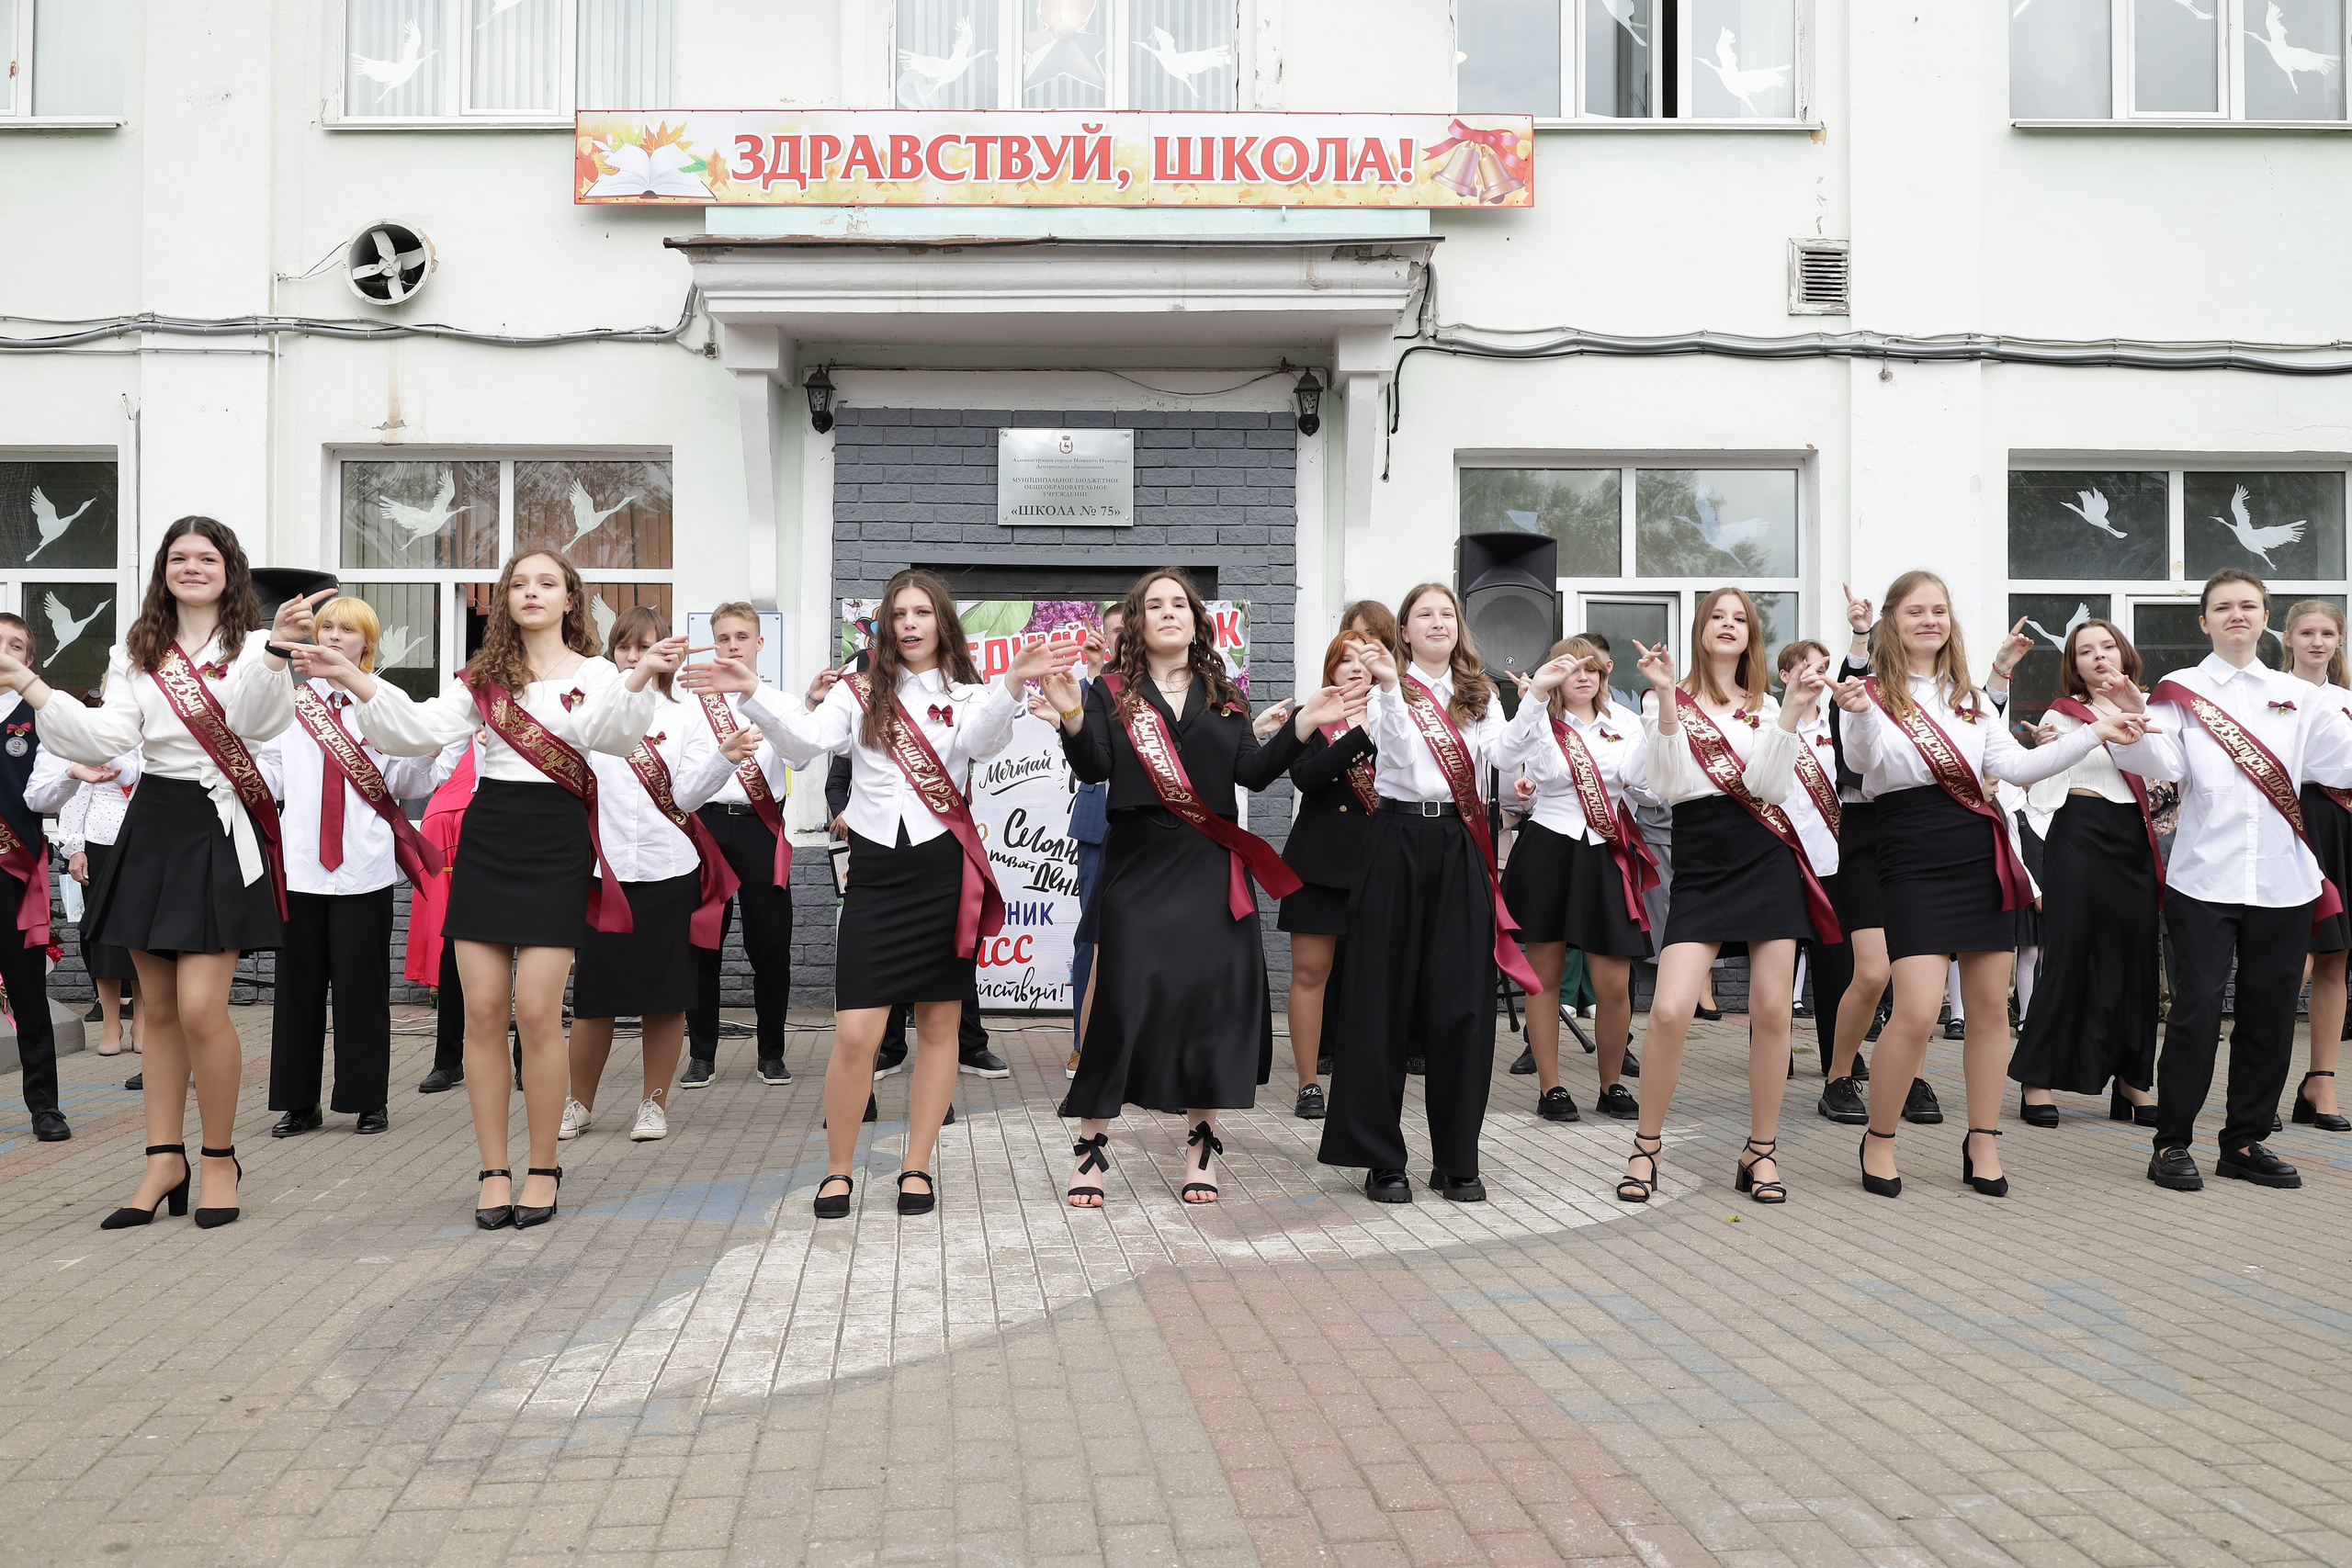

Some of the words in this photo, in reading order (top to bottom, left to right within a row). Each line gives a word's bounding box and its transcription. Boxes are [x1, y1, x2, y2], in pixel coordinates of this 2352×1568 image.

[733, 123, 1128, 189] ЗДРАВСТВУЙ,
[1154, 136, 1416, 183] ШКОЛА!
[1011, 505, 1076, 516] «ШКОЛА
[1080, 505, 1097, 516] №
[1100, 505, 1121, 516] 75»
[978, 750, 1055, 789] Мечтай
[1003, 807, 1078, 866] Сегодн
[989, 849, 1038, 874] твой
[977, 966, 1065, 1010] йствуй!
